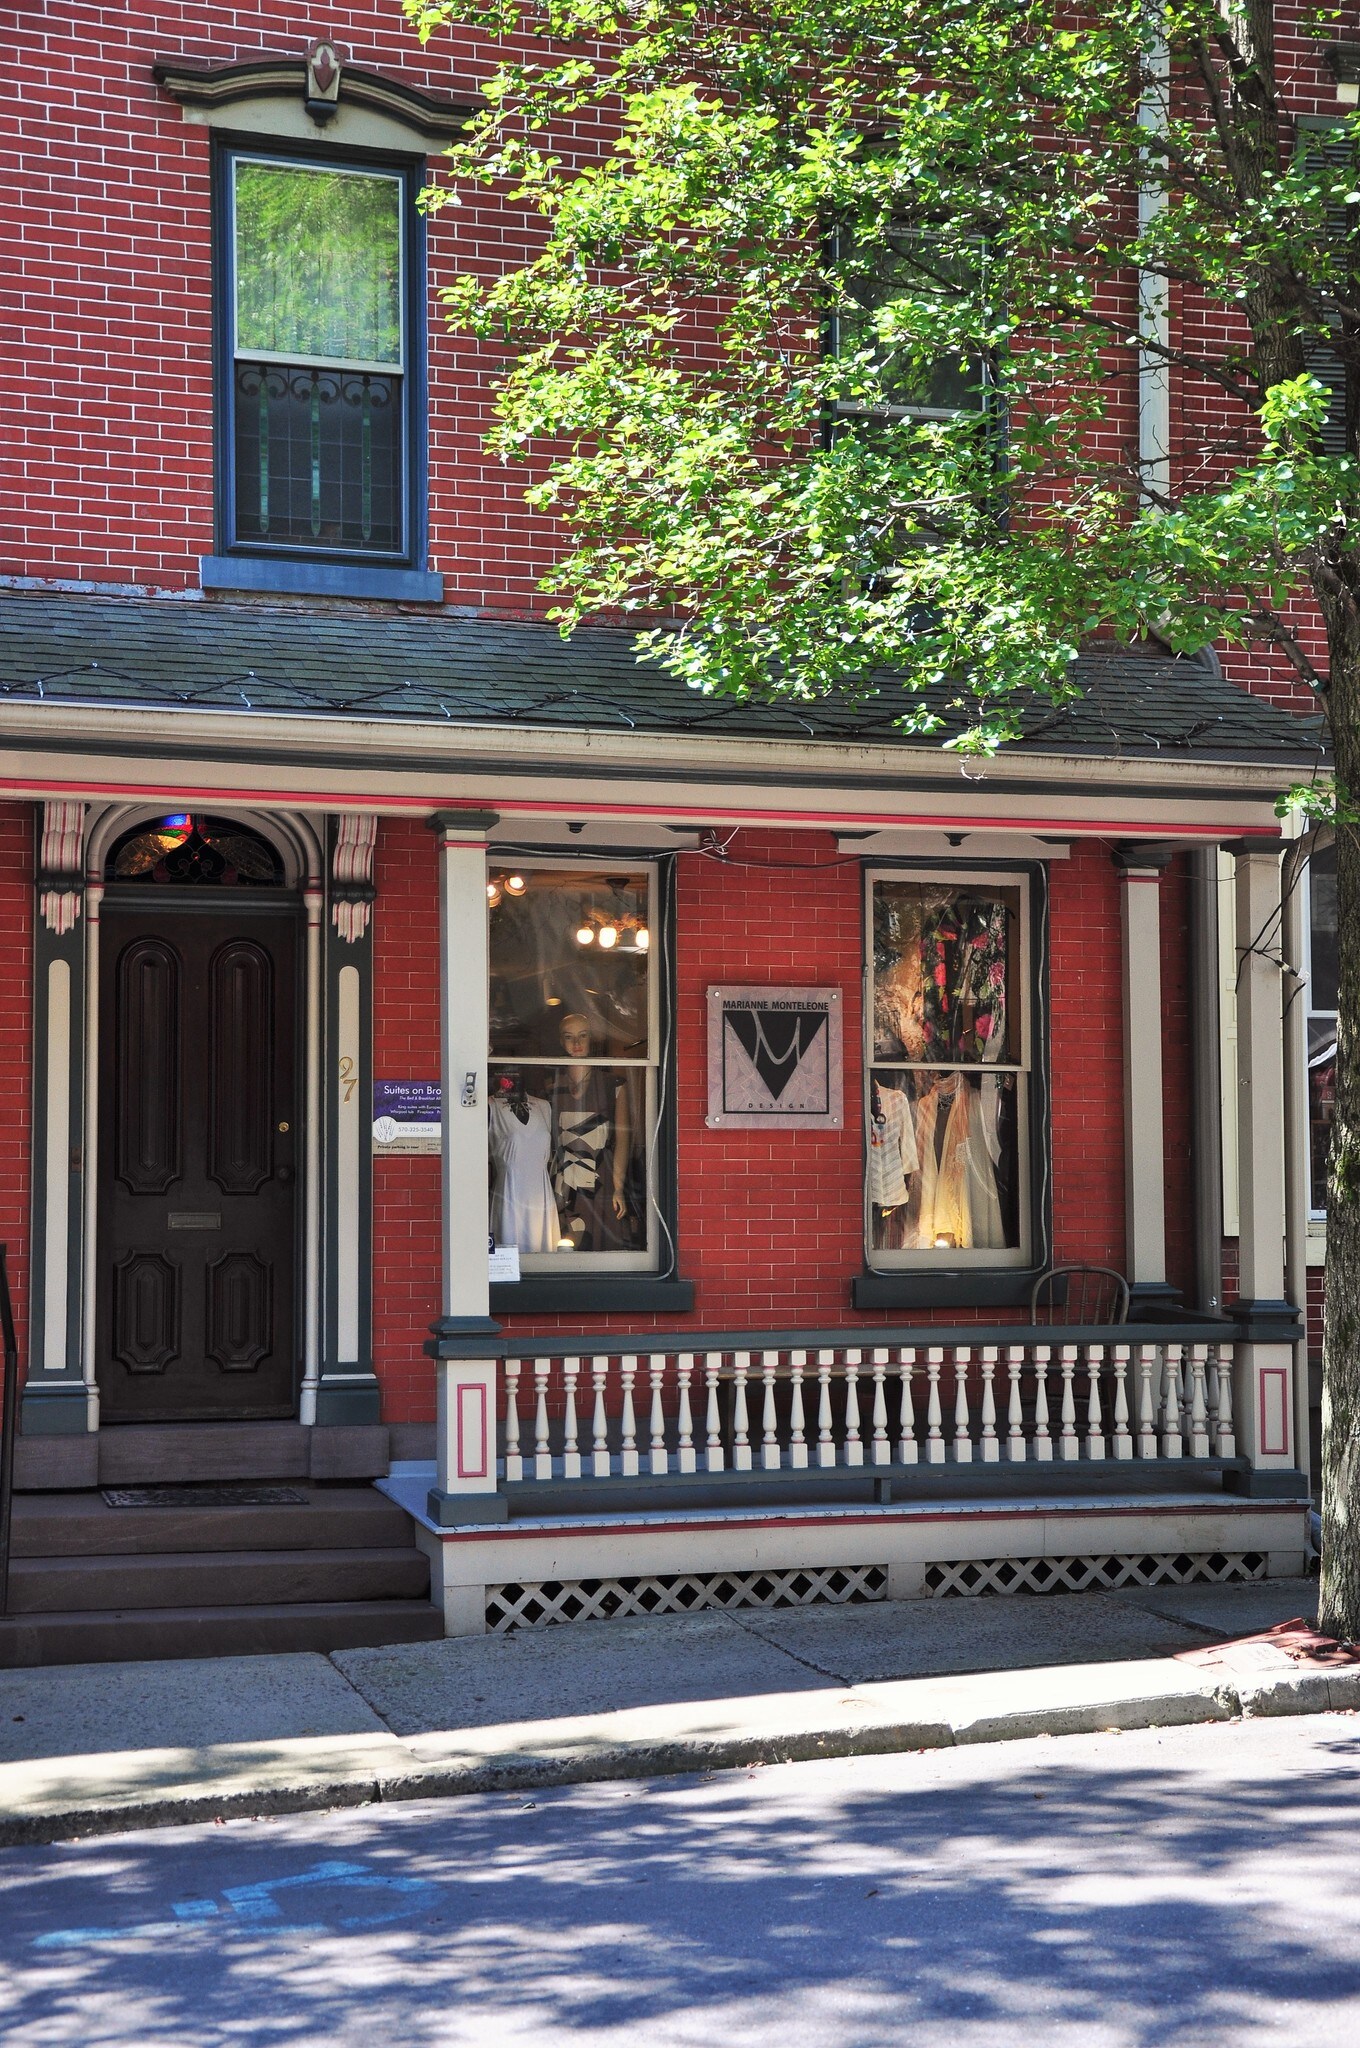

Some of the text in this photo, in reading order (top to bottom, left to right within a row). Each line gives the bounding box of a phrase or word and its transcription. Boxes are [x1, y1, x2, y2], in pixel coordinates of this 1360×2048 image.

[722, 1000, 829, 1011] MARIANNE MONTELEONE
[384, 1085, 410, 1095] Suites
[426, 1085, 442, 1095] Bro
